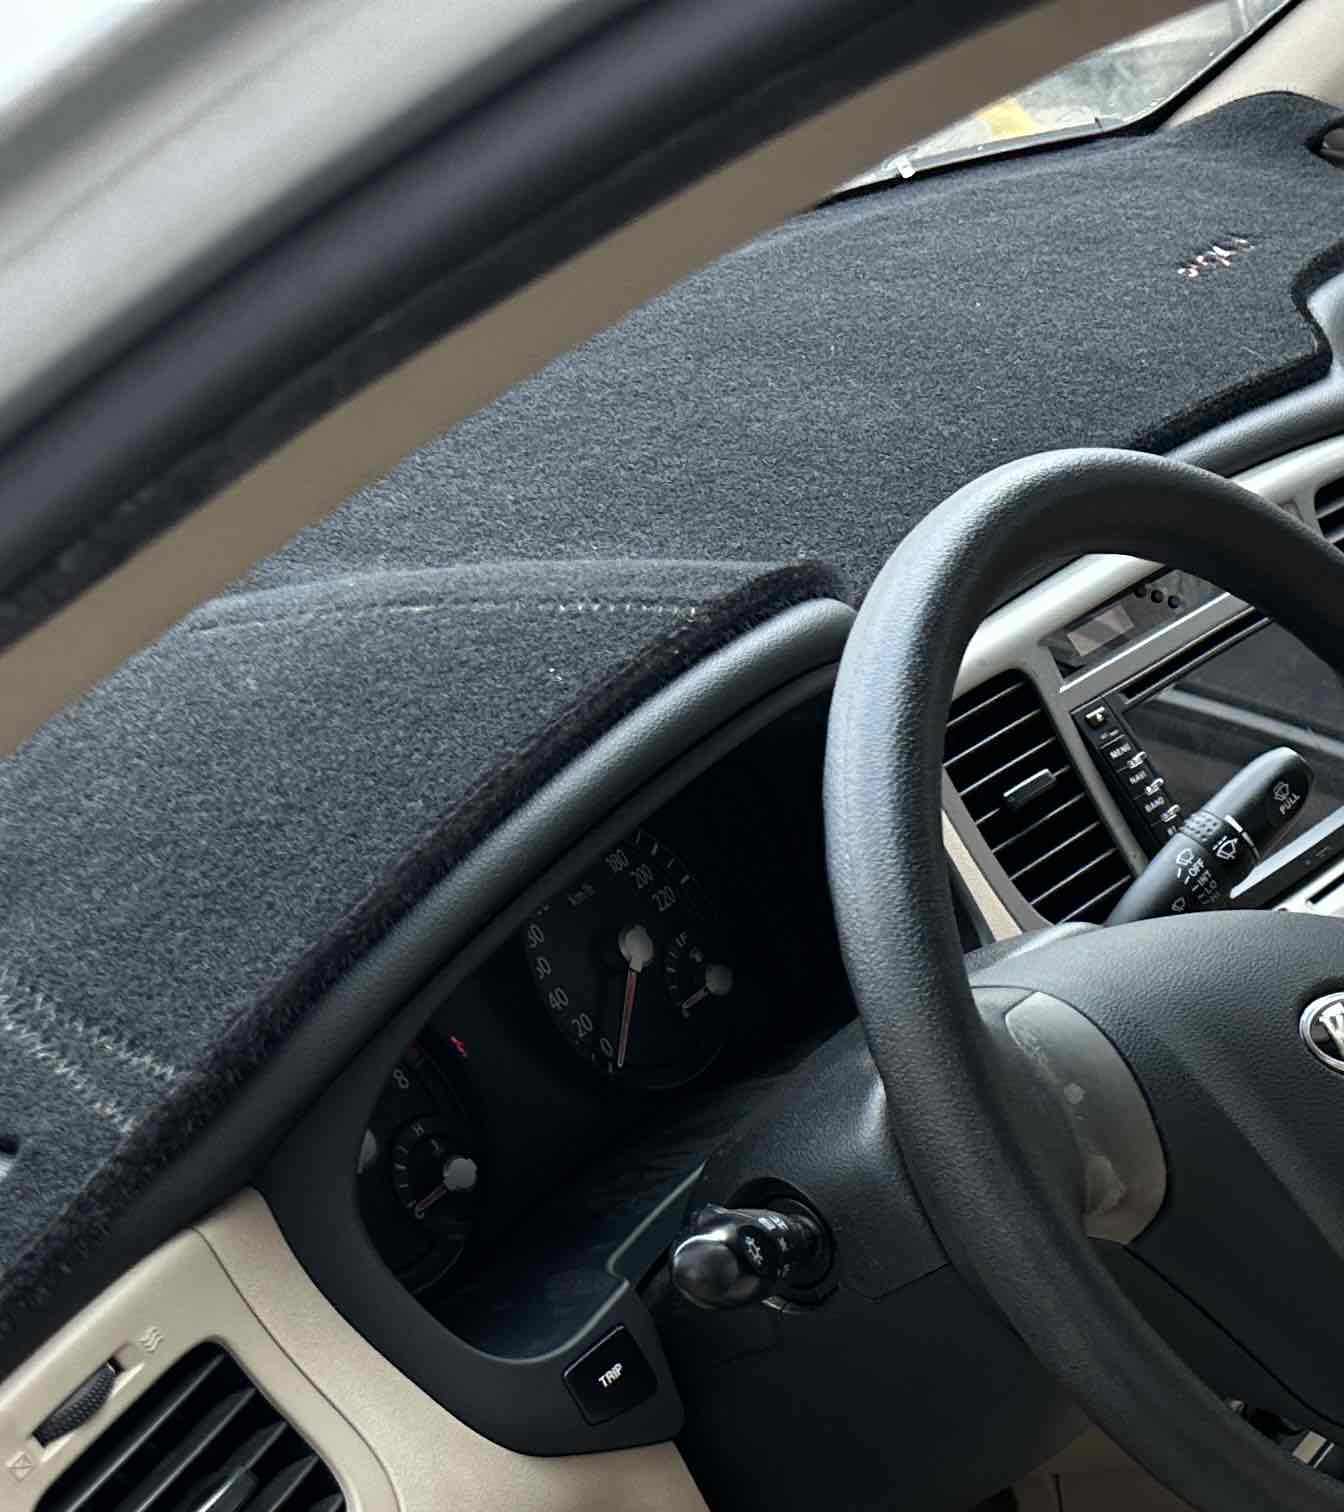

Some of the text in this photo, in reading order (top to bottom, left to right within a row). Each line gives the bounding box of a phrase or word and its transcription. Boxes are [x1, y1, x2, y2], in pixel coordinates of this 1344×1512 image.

[1279, 793, 1301, 815] PULL
[1188, 857, 1205, 877] OFF
[651, 885, 677, 912] 220
[548, 986, 569, 1010] 40
[571, 1012, 593, 1038] 20
[393, 1069, 409, 1088] 8
[598, 1362, 623, 1388] TRIP
